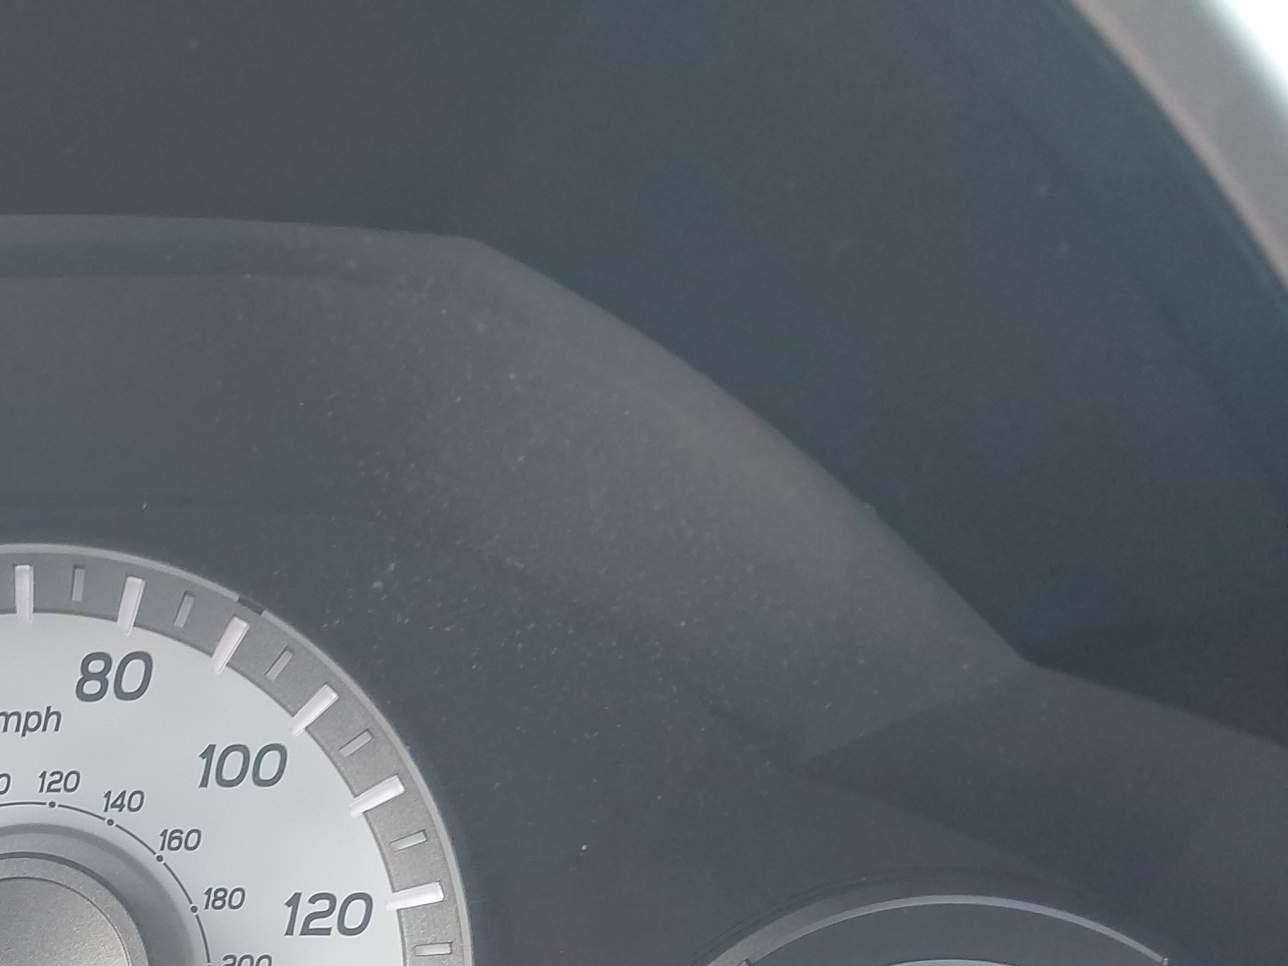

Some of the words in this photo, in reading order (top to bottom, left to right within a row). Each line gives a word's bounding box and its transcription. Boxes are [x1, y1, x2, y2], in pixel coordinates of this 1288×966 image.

[75, 651, 154, 702] 80
[198, 742, 288, 789] 100
[37, 770, 80, 793] 120
[103, 790, 145, 813] 140
[159, 829, 202, 852] 160
[202, 887, 246, 910] 180
[283, 891, 374, 937] 120
